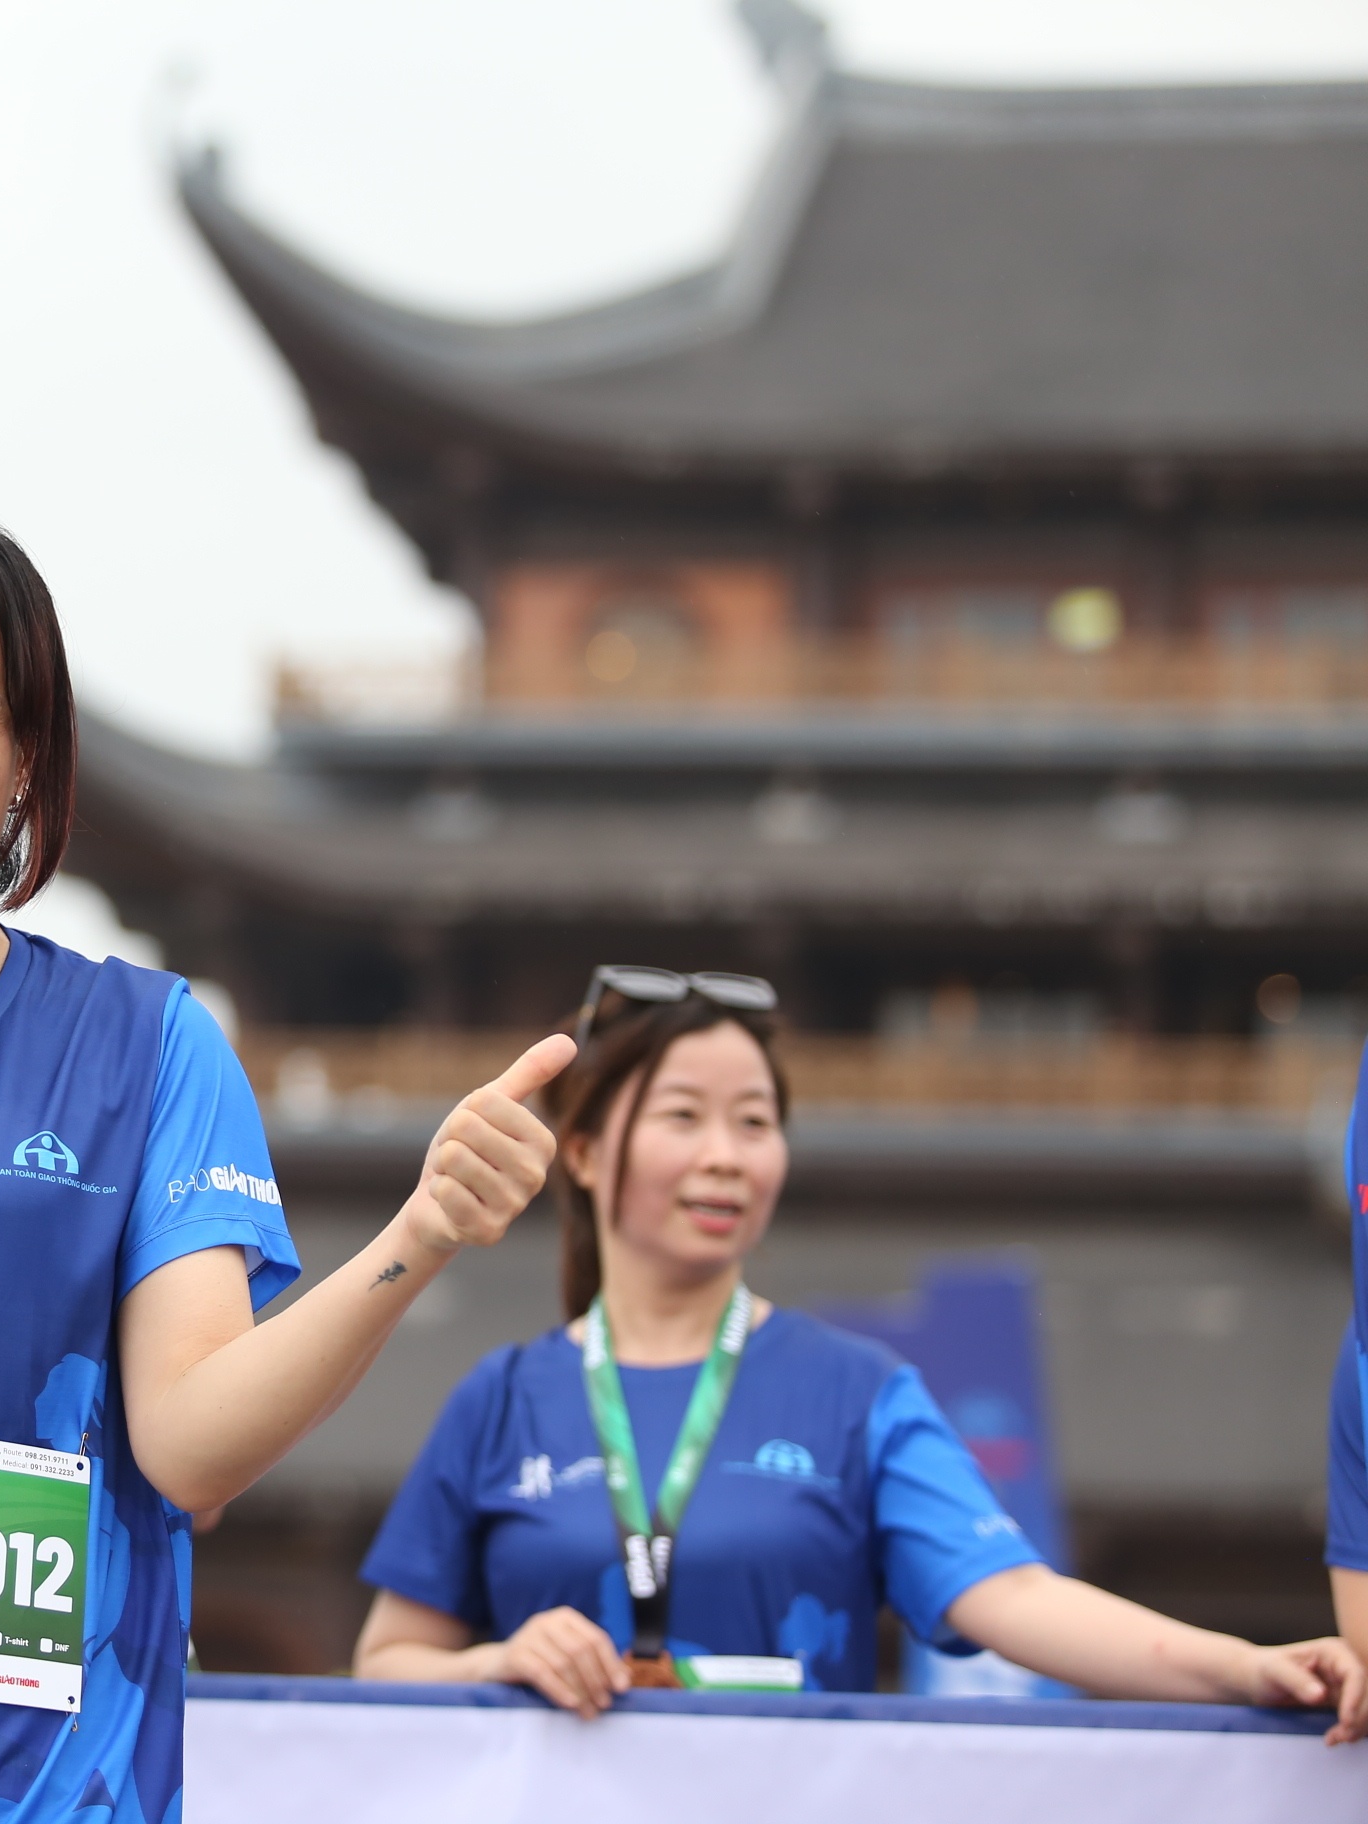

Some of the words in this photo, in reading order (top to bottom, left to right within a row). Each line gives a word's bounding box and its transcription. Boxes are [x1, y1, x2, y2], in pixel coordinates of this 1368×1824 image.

[14, 1169, 36, 1179] TOÀN
[38, 1173, 56, 1183] GIAO
[57, 1176, 80, 1188] THÔNG
[81, 1182, 101, 1193] QUỐC
[102, 1186, 117, 1194] GIA
[3, 1448, 22, 1457] Route:
[25, 1452, 69, 1465] 098.251.9711
[2, 1459, 28, 1468] Medical:
[30, 1463, 74, 1477] 091.332.2233
[5, 1636, 29, 1647] T-shirt
[54, 1643, 70, 1652] DNF
